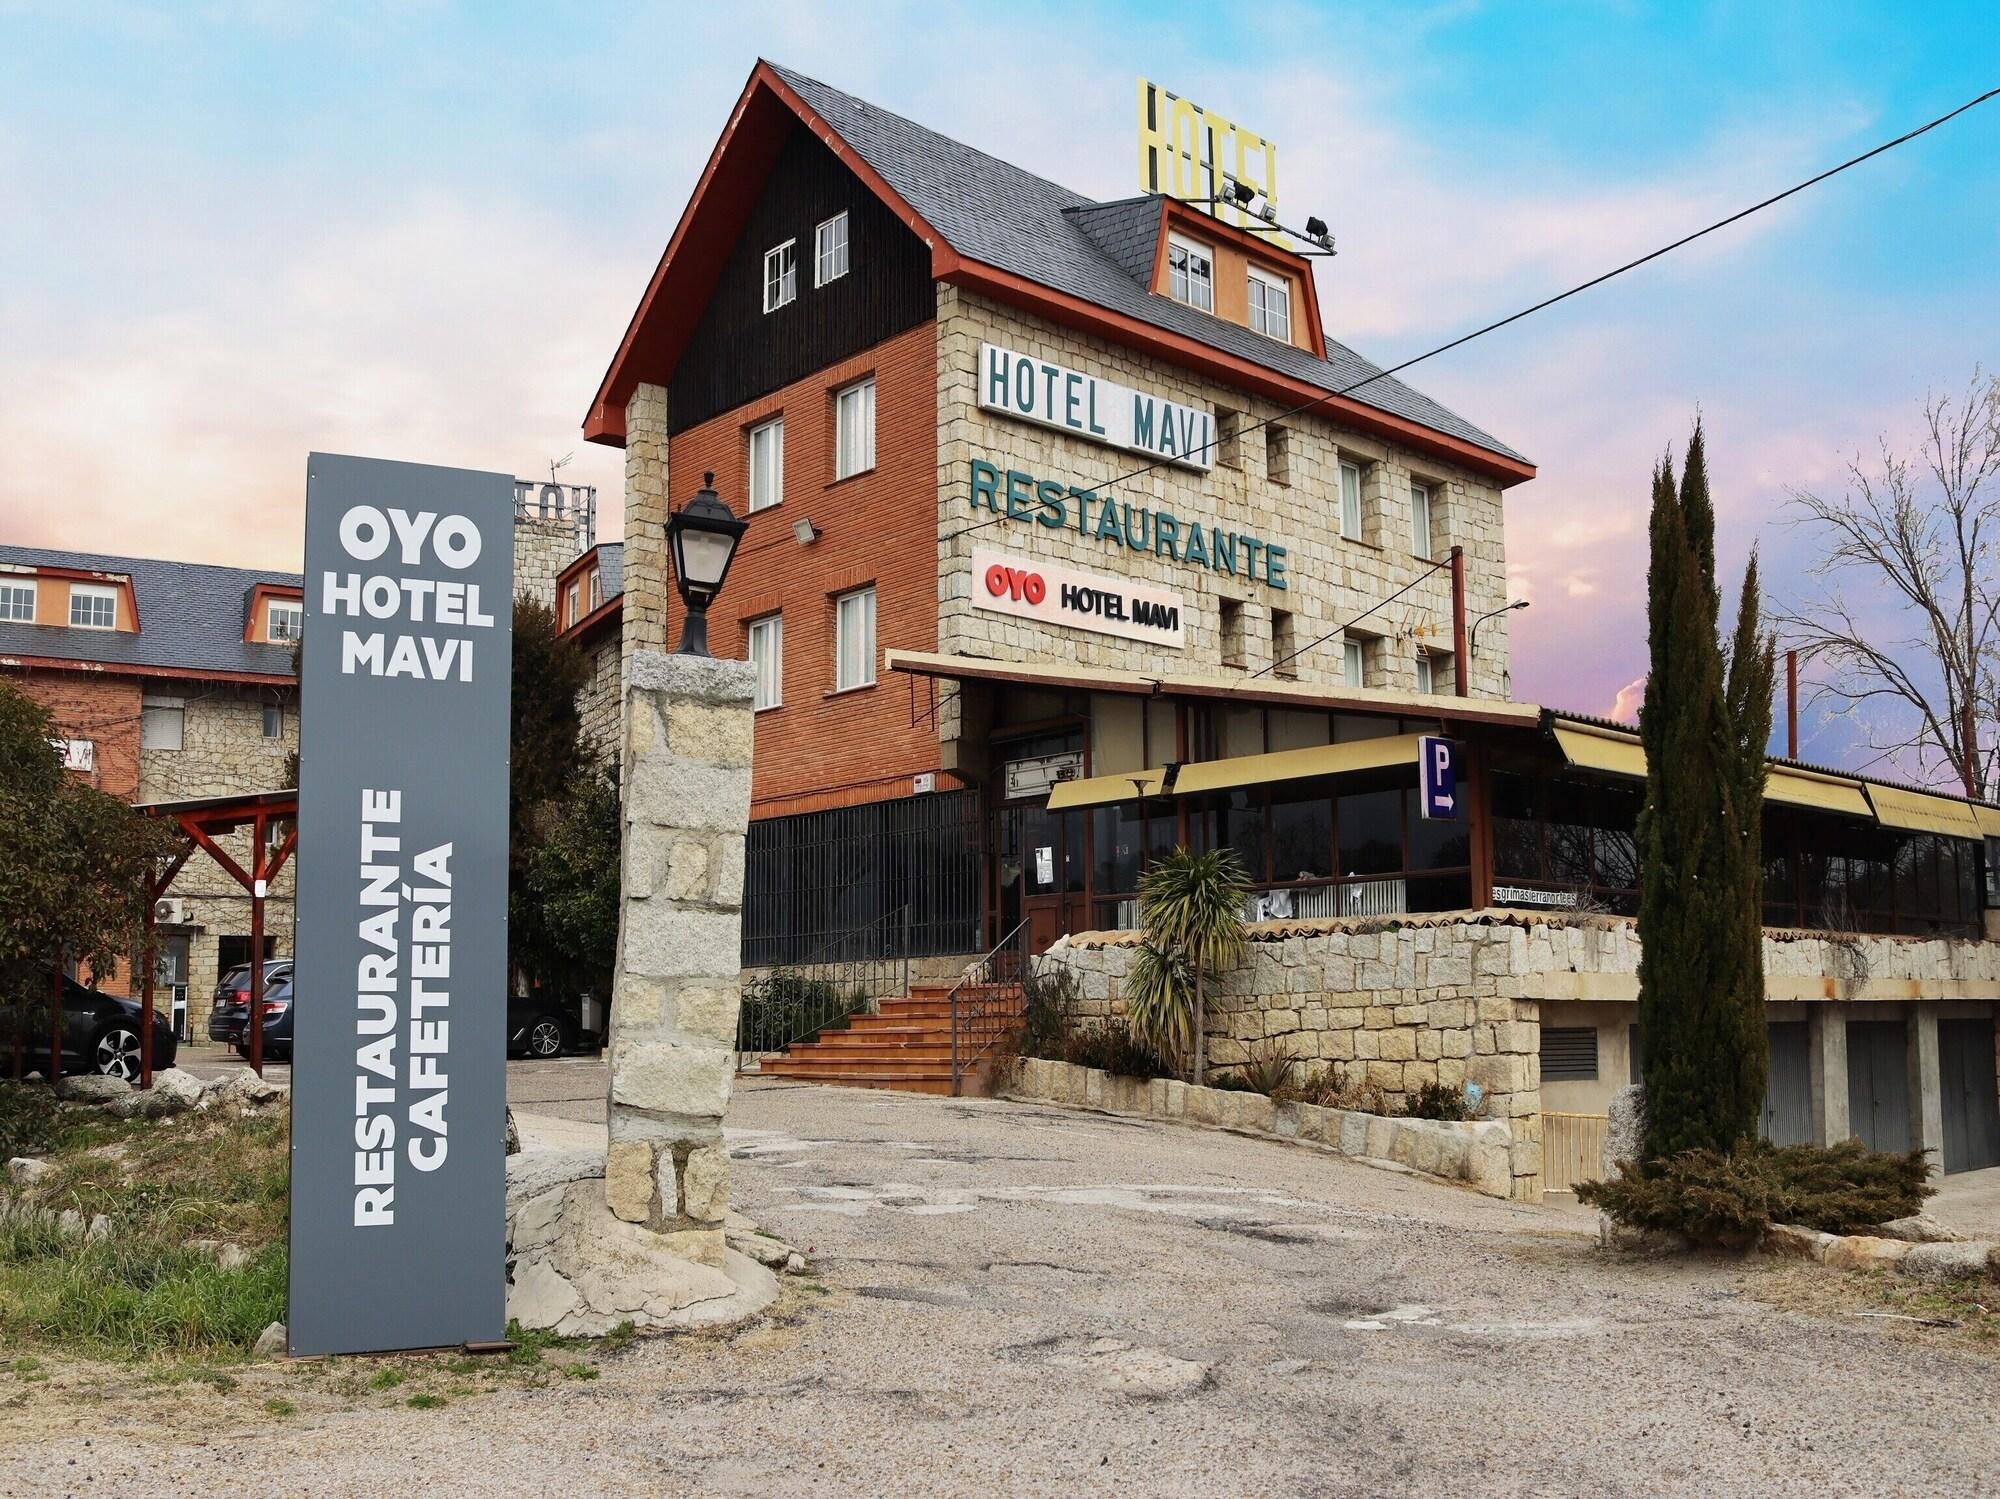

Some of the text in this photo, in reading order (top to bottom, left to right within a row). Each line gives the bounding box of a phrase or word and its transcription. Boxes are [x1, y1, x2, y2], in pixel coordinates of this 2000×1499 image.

[1136, 75, 1293, 251] HOTEL
[989, 348, 1209, 465] HOTEL MAVI
[339, 505, 482, 569] OYO
[970, 458, 1288, 590] RESTAURANTE
[322, 571, 494, 627] HOTEL
[985, 564, 1179, 632] OYO HOTEL MAVI
[342, 631, 473, 682] MAVI
[1435, 744, 1450, 786] P
[354, 789, 401, 1227] RESTAURANTE
[402, 842, 453, 1172] CAFETERÍA
